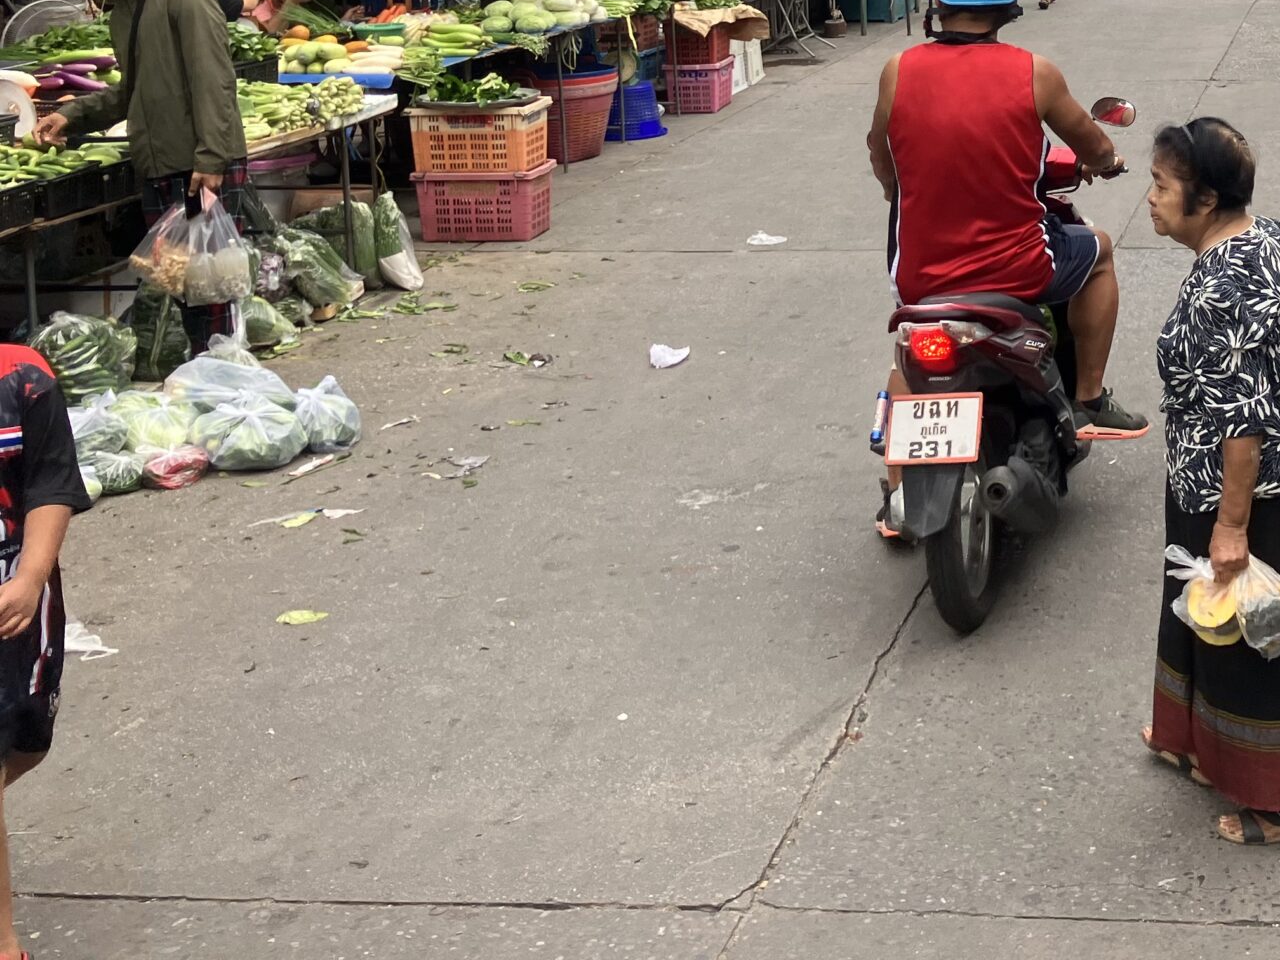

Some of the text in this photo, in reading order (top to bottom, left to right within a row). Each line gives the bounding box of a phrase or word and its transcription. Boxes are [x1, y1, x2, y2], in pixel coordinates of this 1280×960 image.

[920, 423, 947, 439] ภูเก็ต
[908, 440, 953, 459] 231
